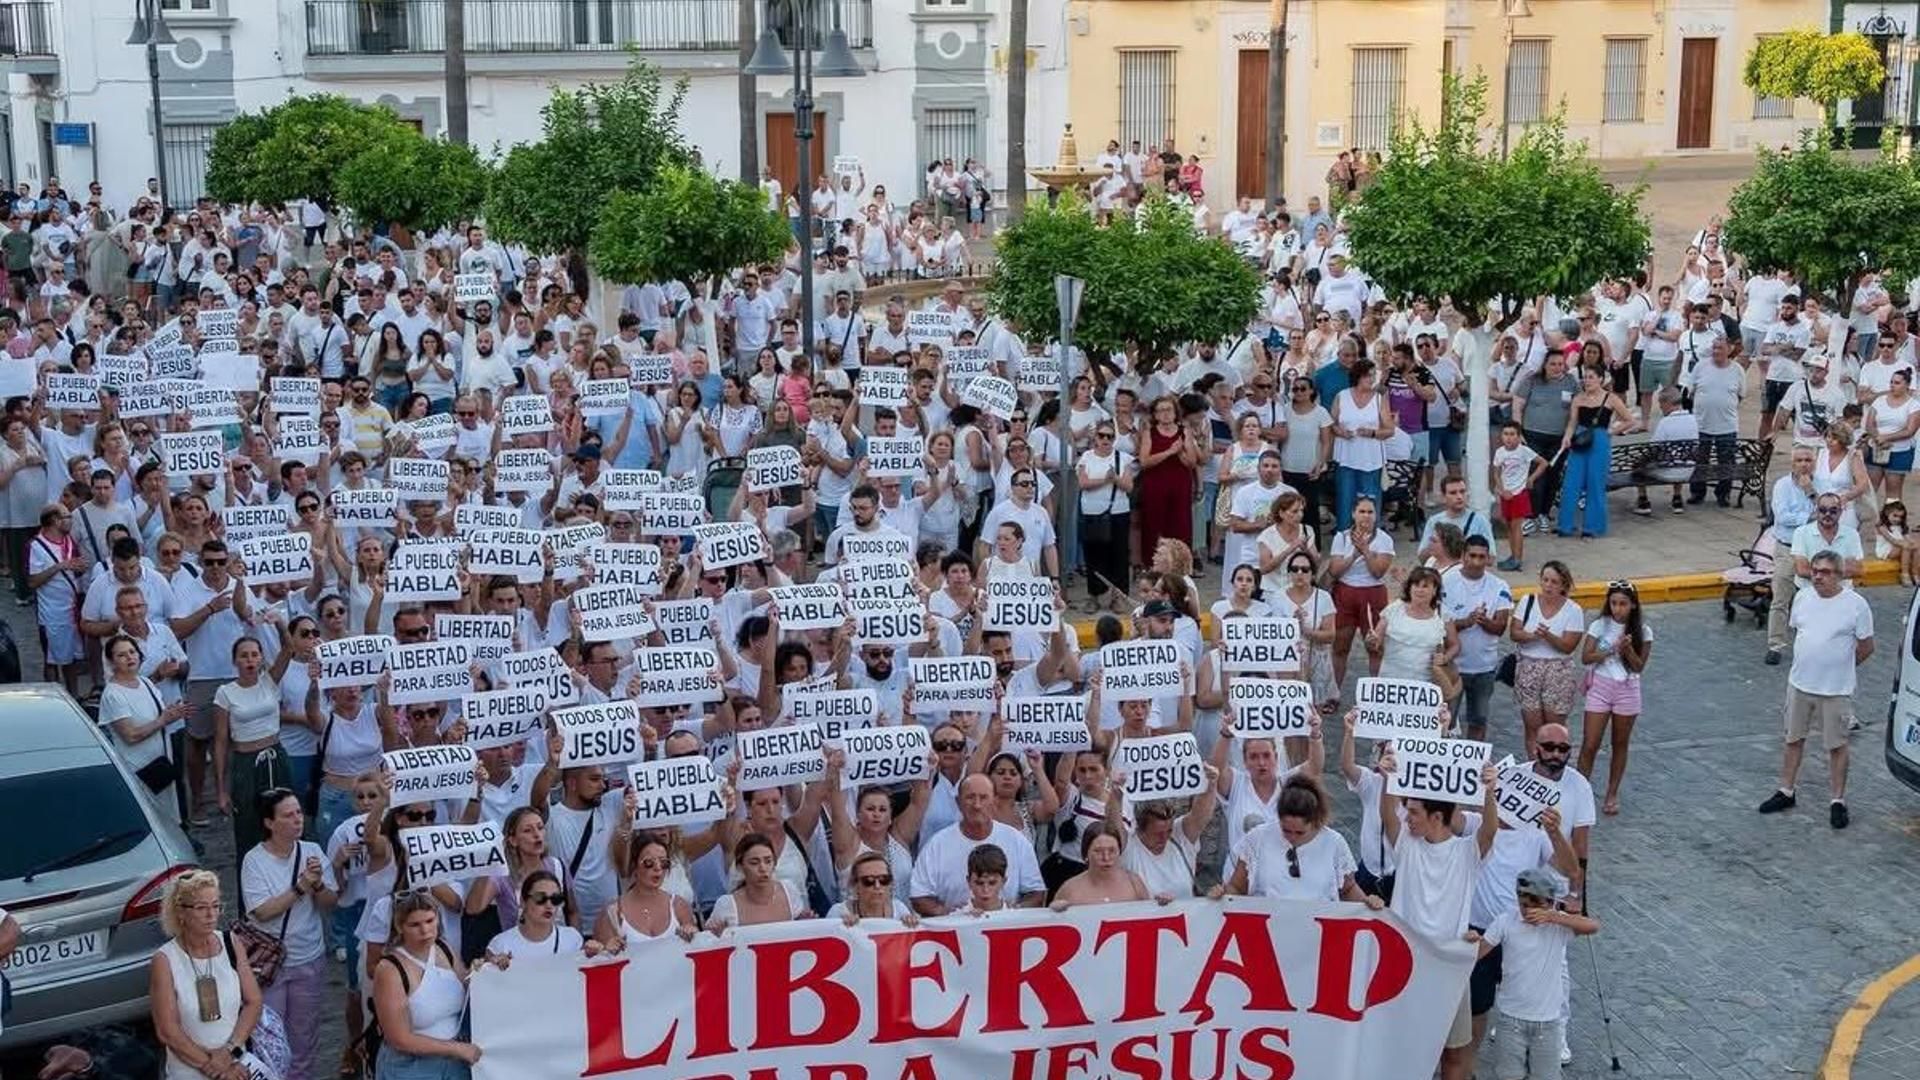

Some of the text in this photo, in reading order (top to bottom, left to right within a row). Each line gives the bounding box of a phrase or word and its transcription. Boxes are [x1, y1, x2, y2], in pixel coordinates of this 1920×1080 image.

[456, 288, 493, 296] HABLA
[912, 315, 950, 325] LIBERTAD
[949, 348, 988, 360] EL PUEBLO
[948, 361, 989, 372] HABLA
[1022, 361, 1060, 372] EL PUEBLO
[49, 378, 98, 389] EL PUEBLO
[862, 372, 907, 382] EL PUEBLO
[1019, 374, 1061, 386] HABLA
[120, 384, 166, 397] EL PUEBLO
[274, 380, 318, 392] LIBERTAD
[581, 382, 628, 396] LIBERTAD
[860, 388, 908, 400] HABLA
[48, 392, 98, 404] HABLA
[120, 396, 170, 412] HABLA
[582, 400, 628, 408] PARA JESUS
[968, 390, 987, 404] PARA
[504, 400, 547, 412] EL PUEBLO
[503, 412, 552, 428] HABLA
[164, 437, 220, 450] TODOS CON
[870, 441, 920, 454] EL PUEBLO
[168, 446, 220, 472] JESÚS
[497, 453, 550, 467] LIBERTAD
[749, 451, 778, 464] TODOS
[869, 458, 922, 469] HABLA
[394, 462, 446, 478] LIBERTAD
[499, 472, 551, 482] PARA JESUS
[753, 458, 800, 486] JESÚS
[418, 482, 446, 492] JESUS
[606, 472, 659, 486] LIBERTAD
[336, 492, 394, 504] EL PUEBLO
[607, 491, 632, 501] PARA
[645, 498, 702, 512] EL PUEBLO
[226, 510, 287, 526] LIBERTAD
[334, 508, 396, 520] HABLA
[458, 510, 518, 528] EL PUEBLO
[643, 515, 701, 528] HABLA
[474, 532, 488, 545] EL
[492, 532, 540, 545] PUEBLO
[696, 524, 730, 539] TODOS
[244, 538, 308, 556] EL PUEBLO
[847, 541, 909, 554] TODOS CON
[389, 556, 402, 570] EL
[406, 554, 456, 570] PUEBLO
[472, 548, 542, 566] HABLA
[595, 551, 608, 564] EL
[612, 551, 658, 566] PUEBLO
[245, 556, 312, 577] HABLA
[844, 564, 909, 582] EL PUEBLO
[386, 576, 459, 592] HABLA
[592, 570, 660, 585] HABLA
[776, 586, 838, 600] EL PUEBLO
[988, 582, 1026, 597] TODOS
[779, 604, 844, 621] HABLA
[851, 600, 892, 610] TODOS
[991, 597, 1052, 626] JESÚS
[584, 611, 648, 630] PARA JESUS
[660, 605, 710, 622] PUEBLO
[440, 620, 511, 639] LIBERTAD
[859, 608, 922, 638] JESÚS
[1227, 624, 1295, 640] EL PUEBLO
[321, 644, 335, 658] EL
[390, 646, 467, 672] LIBERTAD
[1103, 644, 1177, 668] LIBERTAD
[1224, 646, 1298, 662] HABLA
[505, 656, 546, 676] TODOS
[640, 650, 714, 672] LIBERTAD
[914, 660, 992, 683] LIBERTAD
[394, 672, 470, 692] PARA JESUS
[641, 676, 717, 694] PARA JESUS
[1106, 670, 1180, 690] PARA JESUS
[916, 688, 993, 702] PARA JESUS
[1230, 684, 1308, 700] TODOS CON
[1361, 682, 1440, 708] LIBERTAD
[468, 694, 544, 720] EL PUEBLO
[794, 696, 872, 718] EL PUEBLO
[1007, 702, 1084, 724] LIBERTAD
[560, 705, 636, 727] TODOS CON
[1234, 700, 1306, 731] JESÚS
[1360, 710, 1439, 731] PARA JESUS
[466, 717, 542, 742] HABLA
[1008, 730, 1088, 744] PARA JESUS
[568, 722, 636, 760] JESÚS
[742, 729, 821, 760] LIBERTAD
[846, 732, 926, 754] TODOS CON
[1397, 738, 1486, 760] TODOS CON
[392, 746, 472, 771] LIBERTAD
[1124, 743, 1170, 764] TODOS
[744, 759, 824, 780] PARA JESUS
[849, 750, 922, 780] JESÚS
[395, 770, 474, 793] PARA JESUS
[634, 764, 716, 792] EL PUEBLO
[1126, 759, 1201, 794] JESÚS
[1398, 760, 1478, 796] JESÚS
[1510, 772, 1561, 807] PUEBLO
[636, 790, 724, 820] HABLA
[407, 828, 495, 857] EL PUEBLO
[410, 846, 505, 884] HABLA
[58, 934, 95, 958] GJV
[578, 912, 1414, 1078] LIBERTAD
